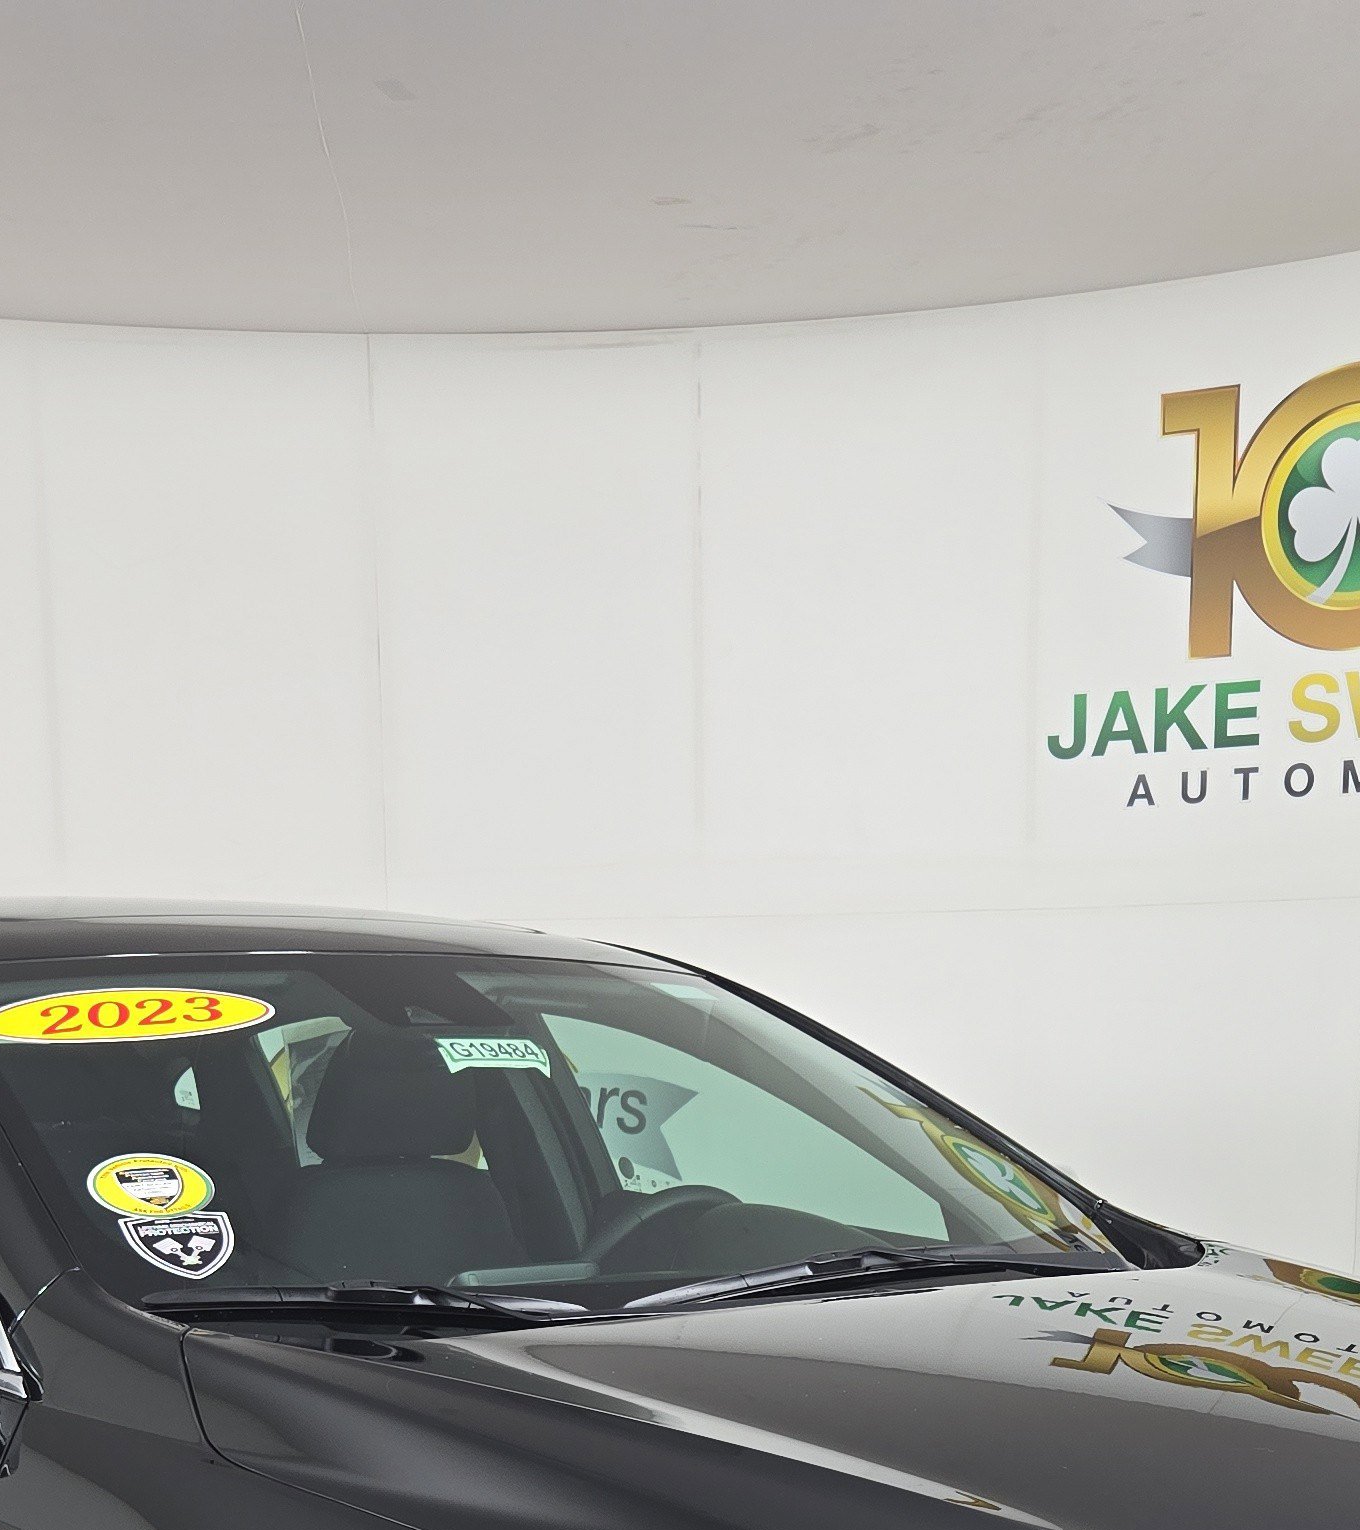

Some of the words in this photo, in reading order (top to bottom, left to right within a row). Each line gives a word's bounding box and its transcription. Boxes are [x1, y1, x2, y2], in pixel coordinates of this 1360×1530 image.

[1046, 679, 1262, 761] JAKE
[40, 997, 224, 1036] 2023
[448, 1041, 540, 1060] G19484
